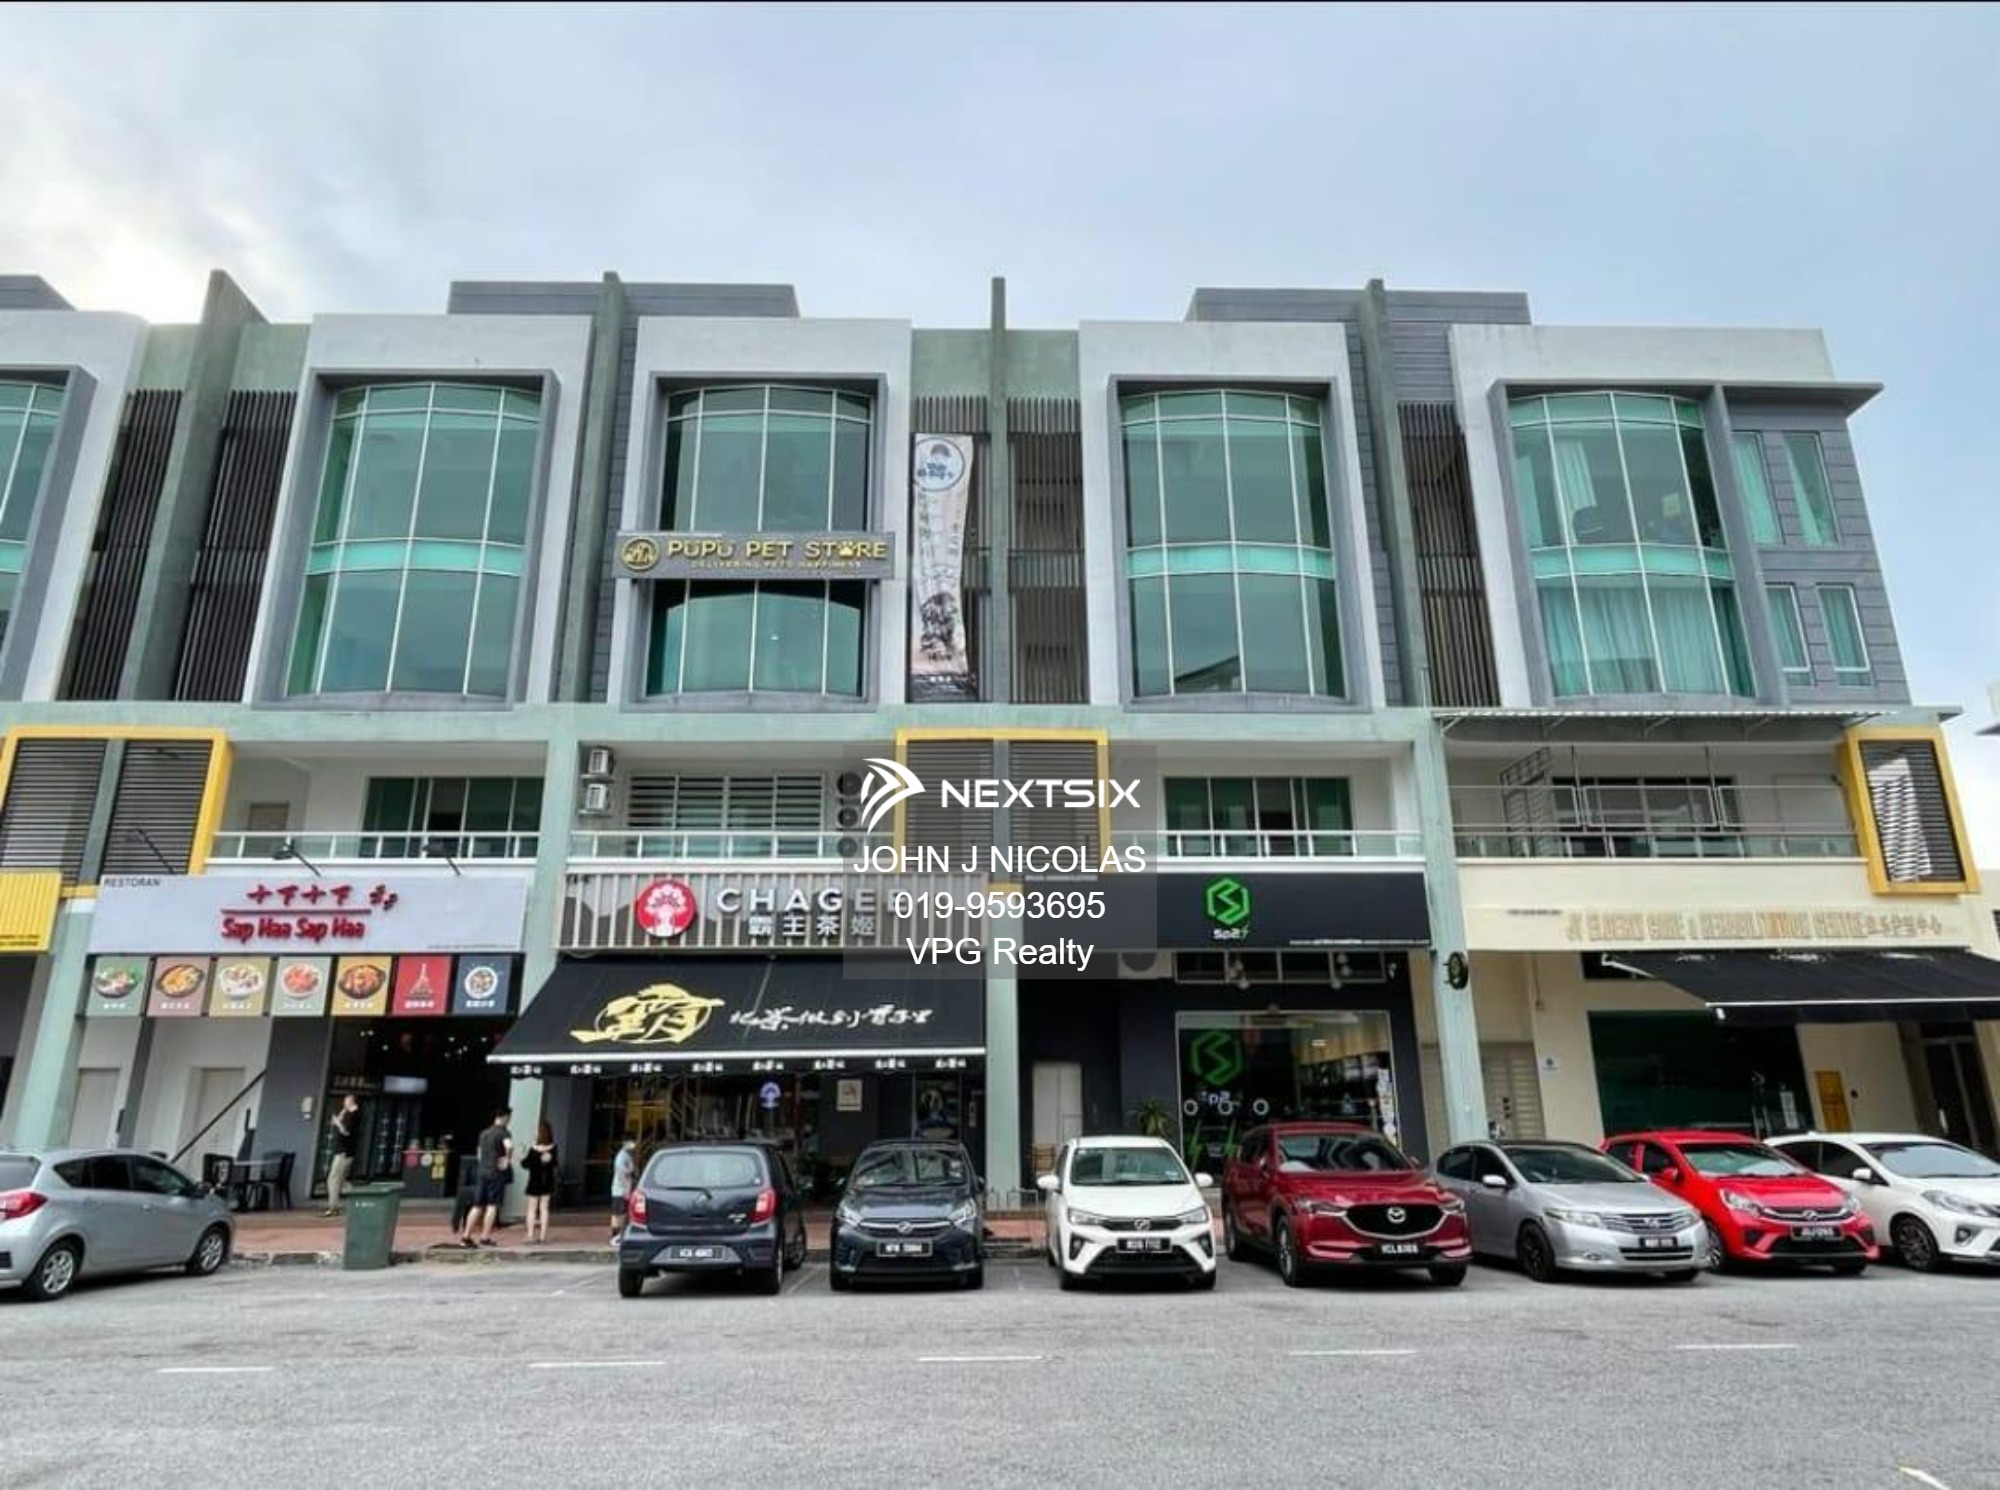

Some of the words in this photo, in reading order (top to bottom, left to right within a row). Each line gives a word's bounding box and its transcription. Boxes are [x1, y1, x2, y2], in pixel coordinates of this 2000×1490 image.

[746, 540, 792, 558] PET
[103, 877, 160, 887] RESTORAN
[222, 917, 254, 943] Sap
[295, 917, 328, 943] Sap
